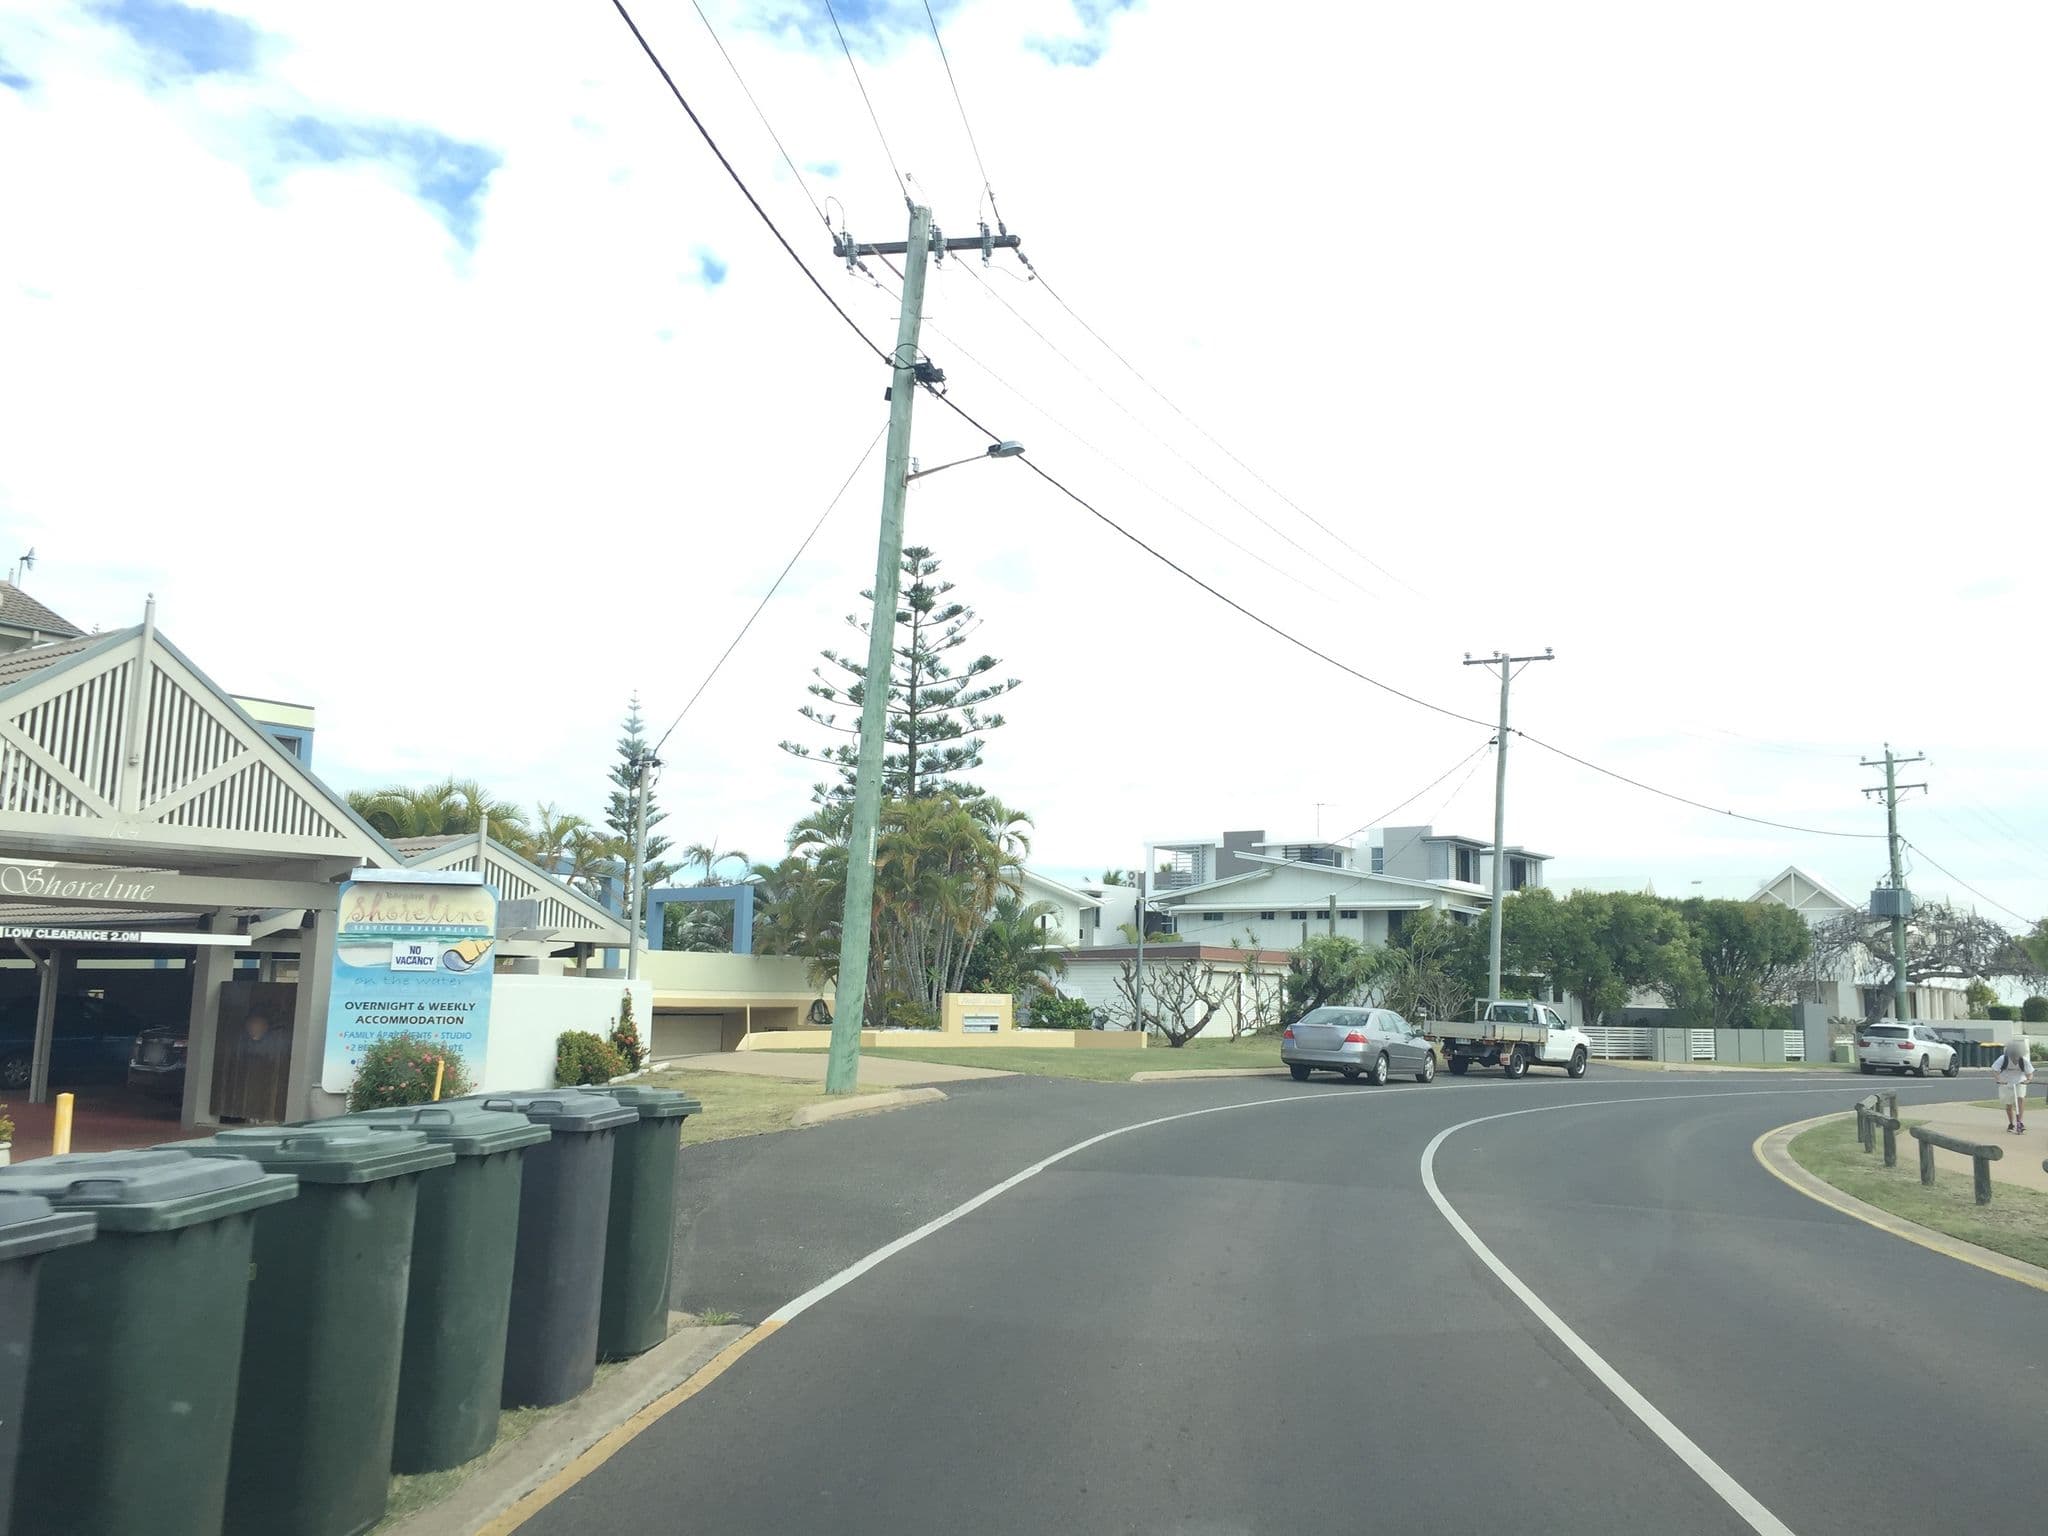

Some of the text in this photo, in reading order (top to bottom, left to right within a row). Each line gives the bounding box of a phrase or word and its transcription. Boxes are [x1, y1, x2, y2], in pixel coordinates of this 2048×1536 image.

[1, 866, 155, 900] Shoreline
[346, 890, 486, 923] Shoreline
[4, 927, 140, 941] LOW CLEARANCE 2.0M
[409, 945, 422, 955] NO
[396, 956, 434, 966] VACANCY
[383, 975, 410, 985] the
[416, 976, 464, 985] water
[344, 1001, 476, 1012] OVERNIGHT & WEEKLY
[355, 1015, 465, 1025] ACCOMMODATION
[343, 1031, 375, 1039] FAMILY
[440, 1031, 472, 1040] STUDIO
